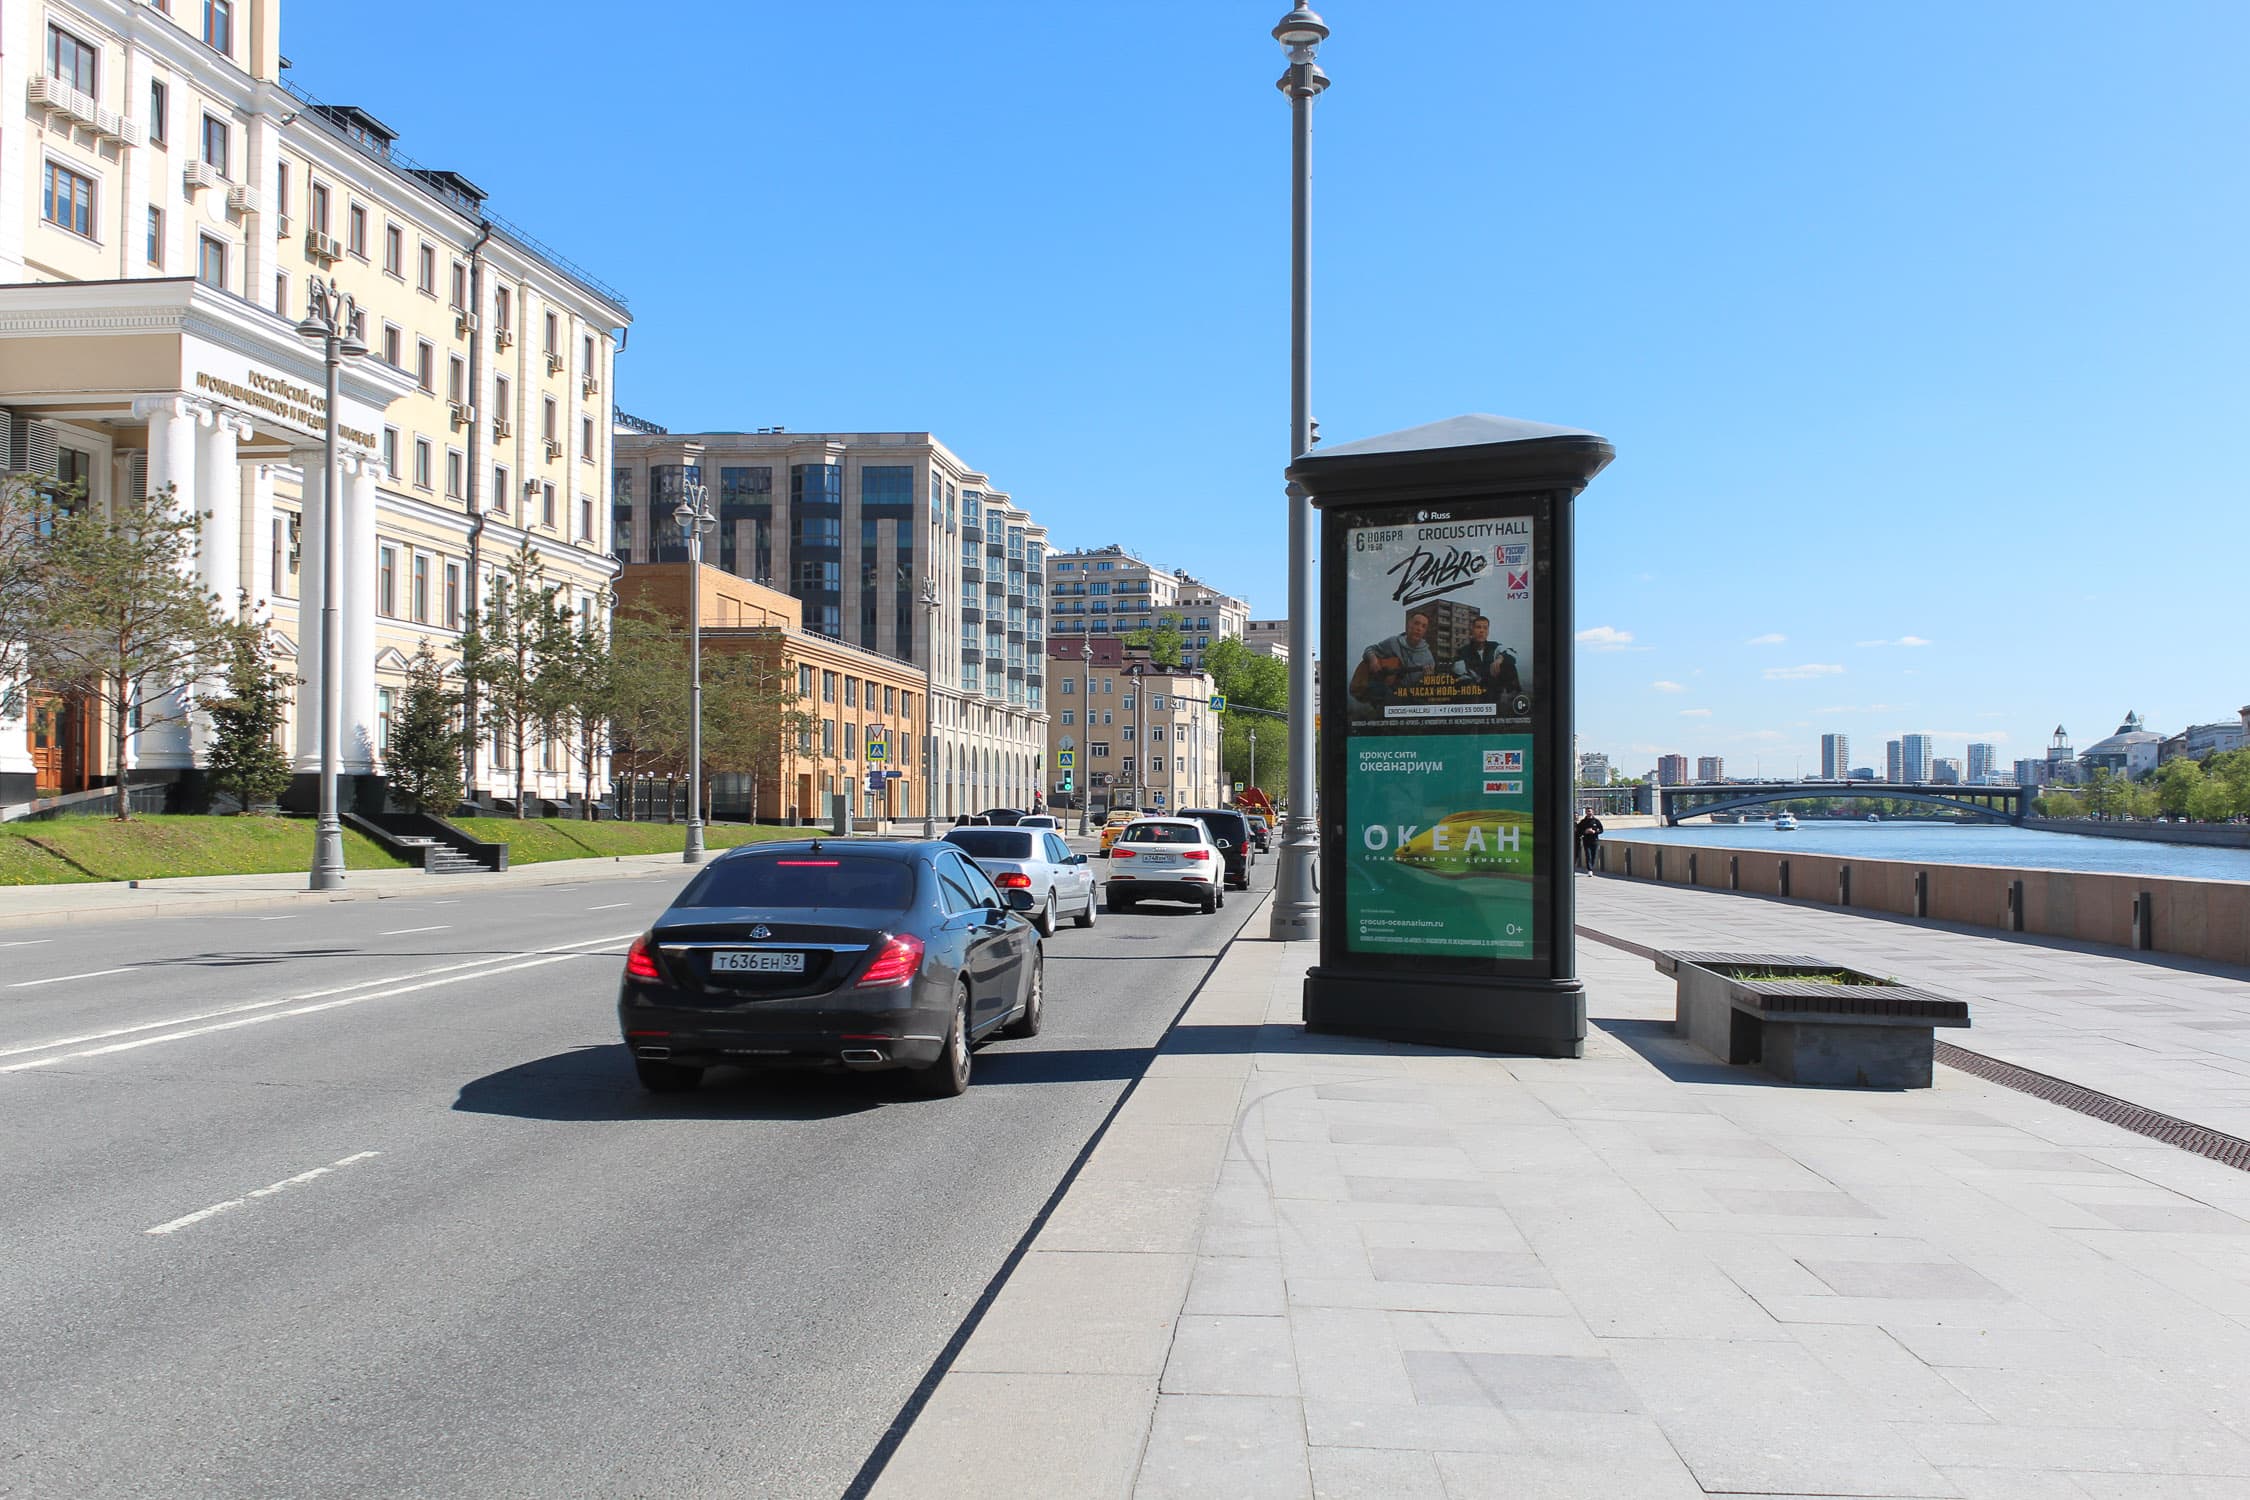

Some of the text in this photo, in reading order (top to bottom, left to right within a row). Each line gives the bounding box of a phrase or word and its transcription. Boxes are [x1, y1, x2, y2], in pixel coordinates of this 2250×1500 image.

[196, 371, 289, 418] ПРОМЫШЛЕННИКОВ
[289, 406, 297, 420] И
[248, 370, 327, 412] РОССИЙСКИЙ СО
[1431, 512, 1451, 520] Russ
[1418, 521, 1528, 541] CROCUS CITY HALL
[1356, 530, 1403, 552] 6 НОЯБРЯ
[1507, 592, 1528, 600] МУЗ
[1410, 686, 1434, 697] ЧАСАХ
[1360, 751, 1417, 761] крокус сити
[1360, 760, 1443, 774] океанариум
[1364, 824, 1520, 852] ОКЕАН
[1360, 918, 1444, 928] crocus-oceanarium.ru
[1506, 923, 1523, 935] 0+
[783, 954, 799, 966] 39
